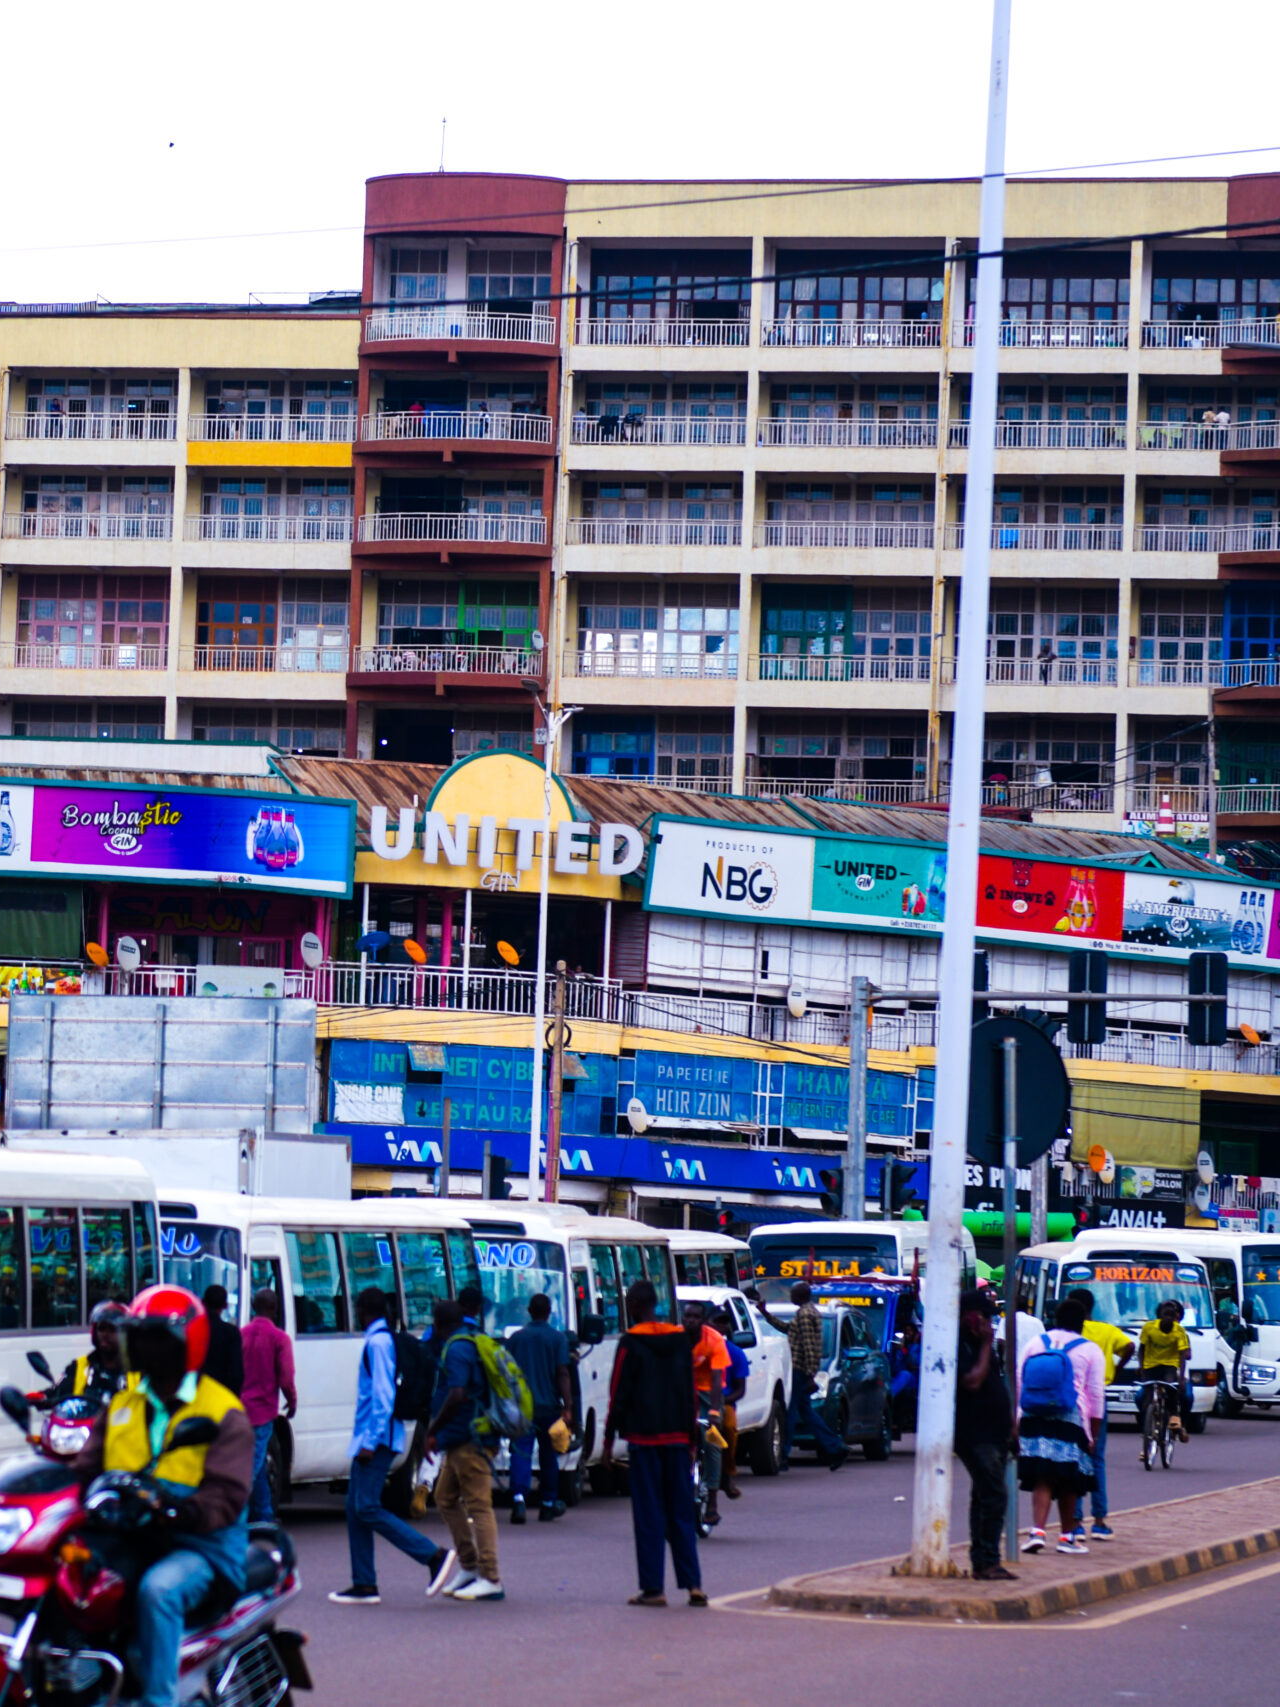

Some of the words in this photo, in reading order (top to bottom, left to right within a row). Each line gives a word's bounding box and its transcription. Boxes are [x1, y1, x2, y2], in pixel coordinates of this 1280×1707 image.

[62, 801, 182, 828] Bombastic
[1129, 812, 1208, 822] ALIMATION
[99, 822, 146, 836] Coconut
[112, 836, 134, 847] GIN
[371, 806, 645, 876] UNITED
[706, 840, 756, 853] PRODUCTS
[762, 846, 774, 854] OF
[480, 869, 521, 892] GIN
[701, 857, 773, 904] NBG
[834, 860, 897, 881] UNITED
[857, 877, 873, 888] GIN
[1000, 889, 1042, 904] INGWE
[1143, 902, 1221, 922] AMERIKAAN
[797, 1071, 888, 1100] HAMA
[415, 1100, 533, 1123] RESTAURA
[656, 1088, 731, 1117] HORIZON
[1155, 1179, 1182, 1189] SALON
[1100, 1209, 1166, 1229] ANAL+
[1094, 1266, 1174, 1282] HORIZON
